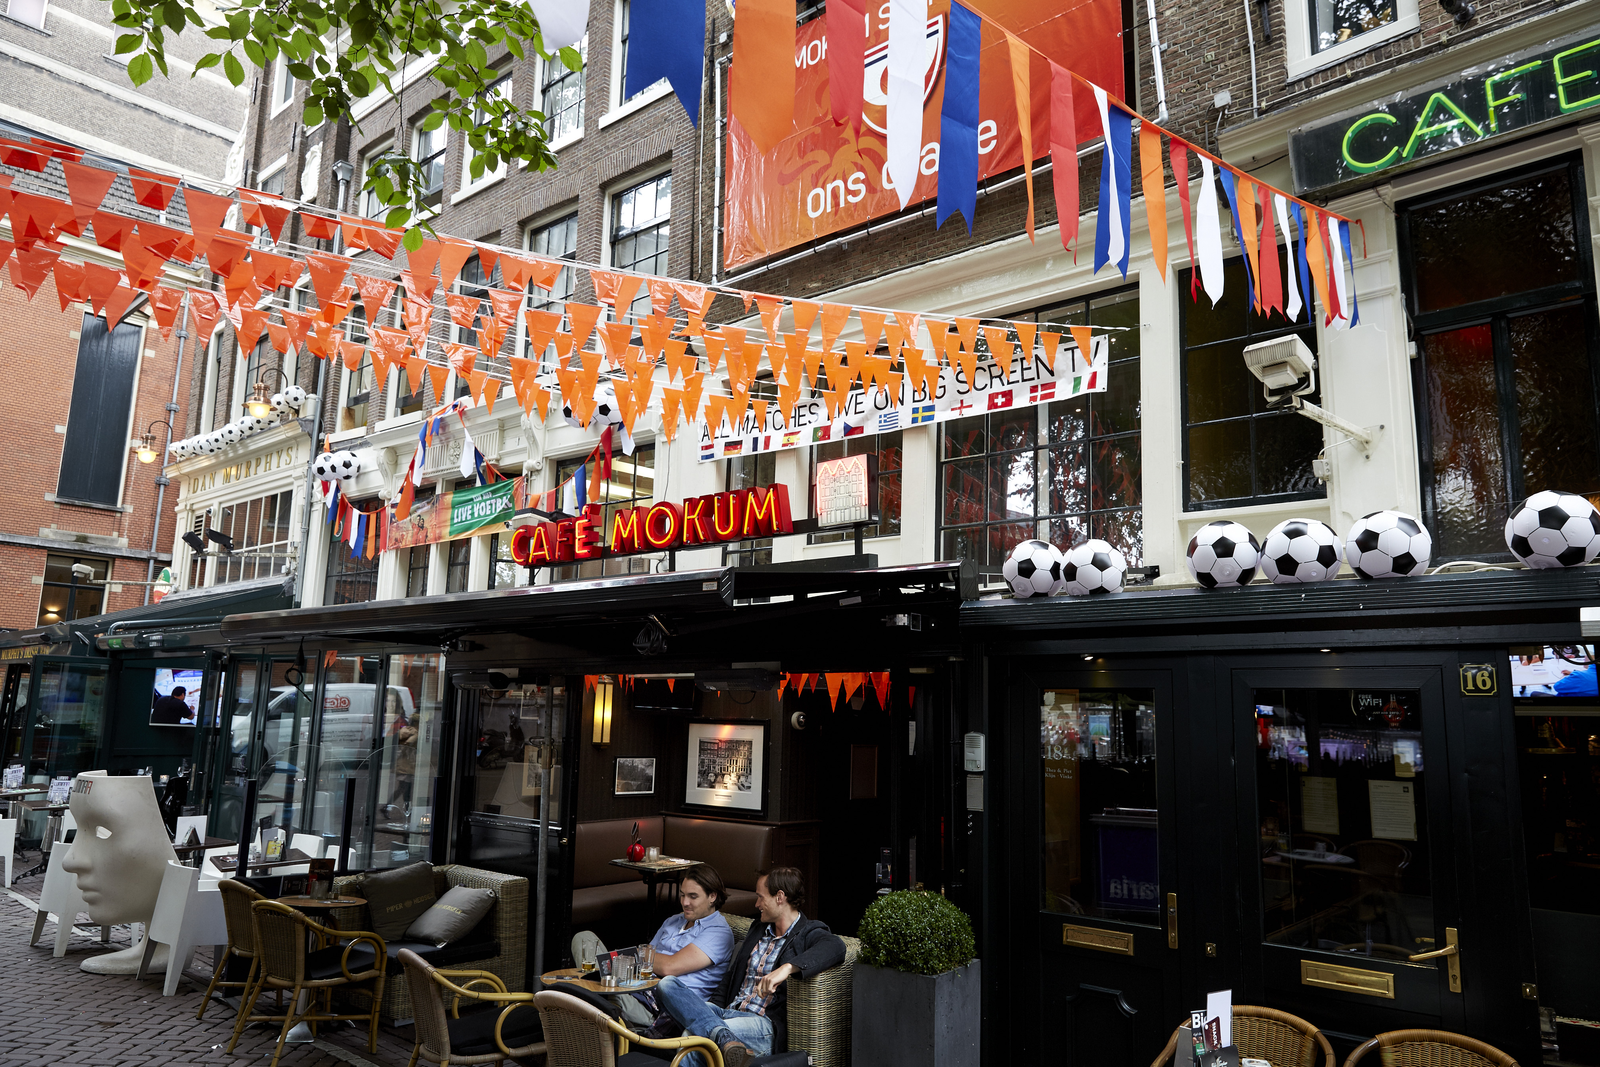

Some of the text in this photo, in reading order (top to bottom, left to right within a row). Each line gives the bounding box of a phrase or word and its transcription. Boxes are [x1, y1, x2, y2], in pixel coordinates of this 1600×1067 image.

[1342, 38, 1600, 173] CAFE
[807, 171, 866, 219] ons
[192, 446, 293, 495] DAN MURPHYS
[454, 506, 472, 524] LIVE
[510, 482, 793, 566] CAFÉ MOKUM
[1464, 670, 1492, 690] 16
[1191, 1012, 1207, 1029] Bi
